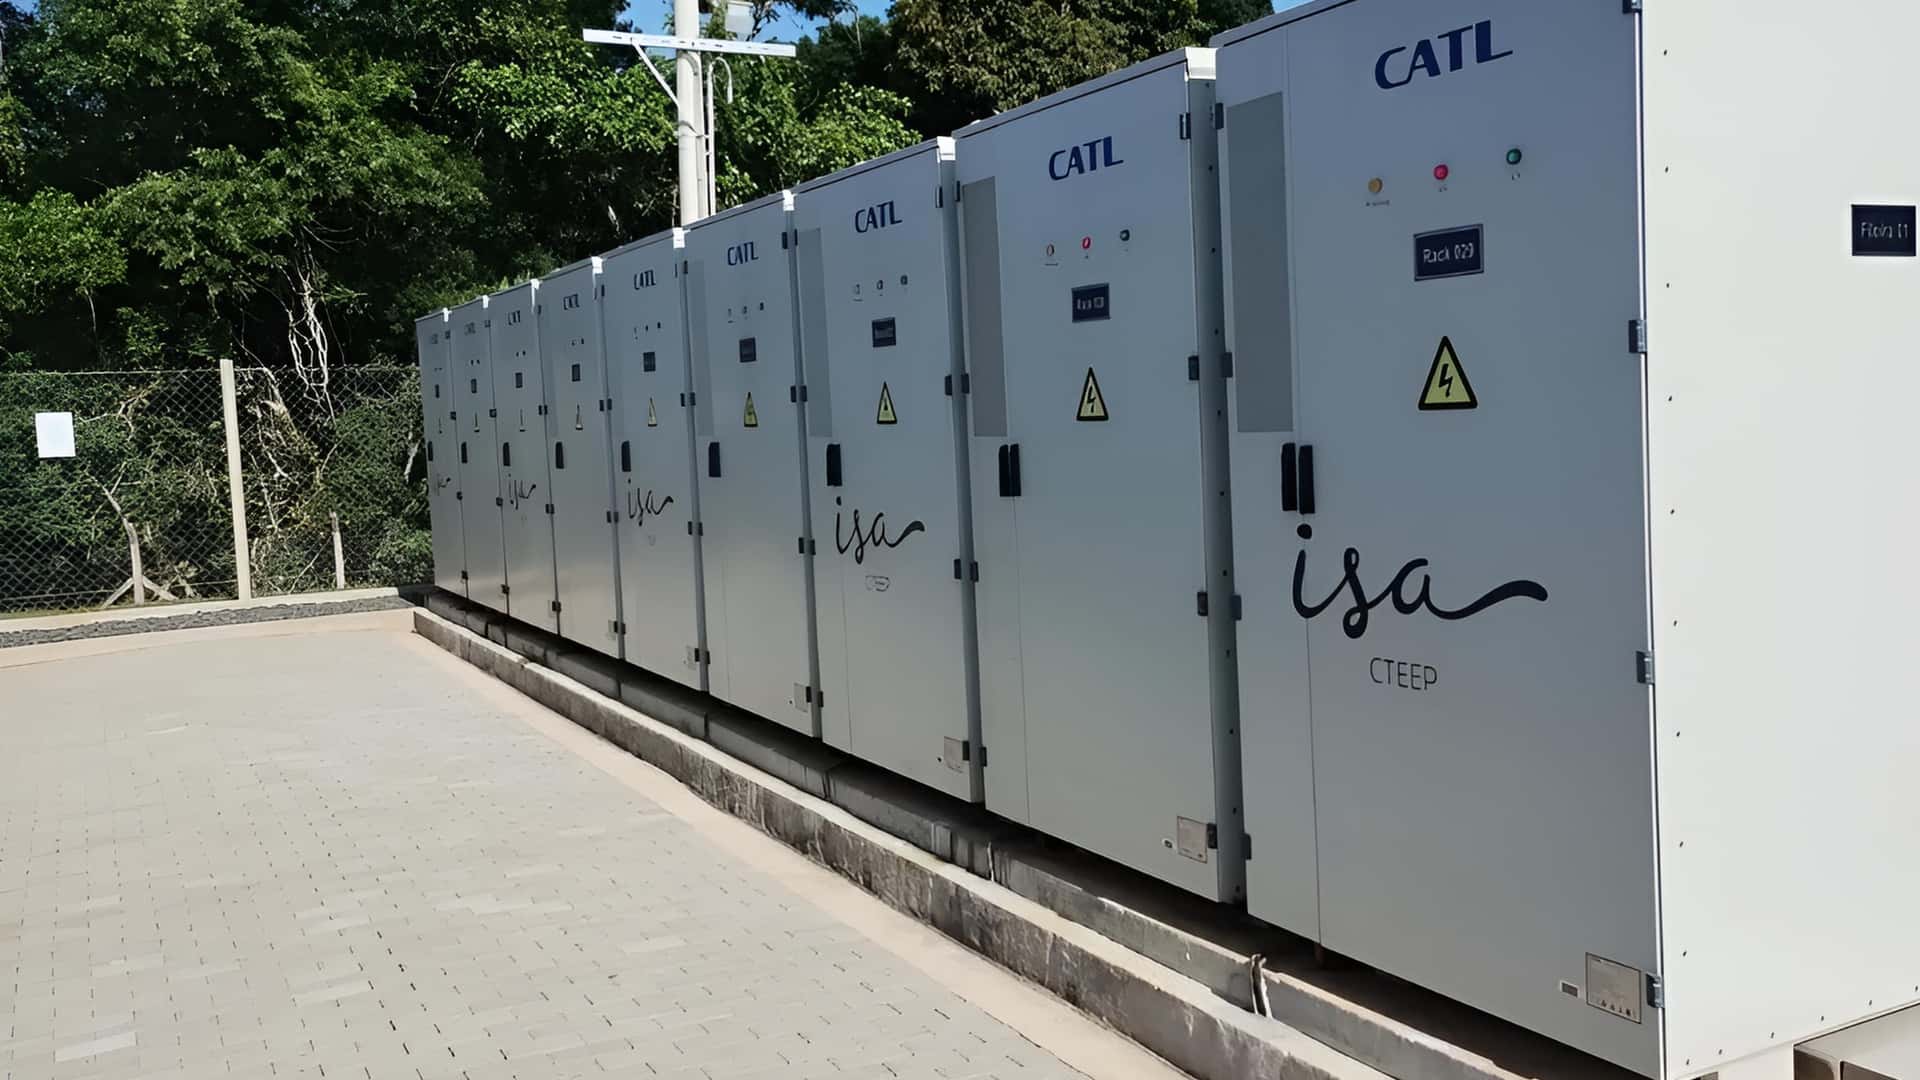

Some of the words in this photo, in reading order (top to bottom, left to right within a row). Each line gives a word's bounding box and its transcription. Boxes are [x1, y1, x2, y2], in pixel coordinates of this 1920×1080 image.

[1375, 20, 1513, 89] CATL
[1049, 136, 1124, 181] CATL
[855, 200, 903, 233] CATL
[727, 241, 759, 266] CATL
[836, 496, 925, 565] isa
[1292, 523, 1548, 639] isa
[1369, 657, 1438, 691] CTEEP
